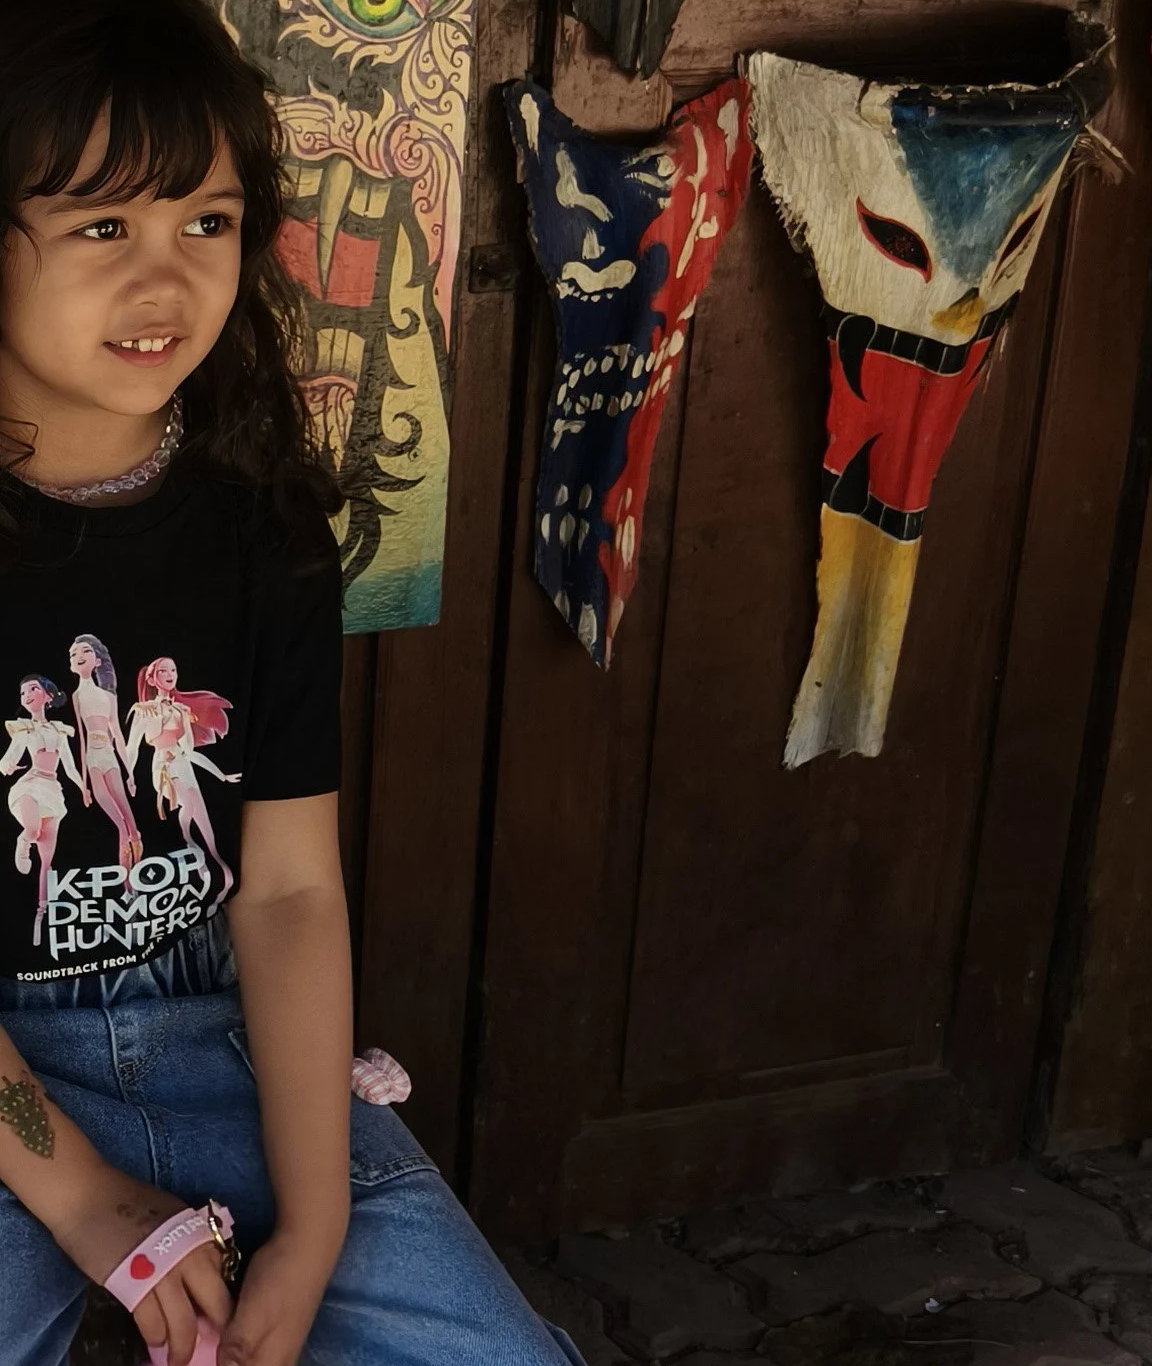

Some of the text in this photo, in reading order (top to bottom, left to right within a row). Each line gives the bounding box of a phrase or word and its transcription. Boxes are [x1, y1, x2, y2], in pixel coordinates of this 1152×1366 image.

[46, 847, 206, 901] K-POP
[47, 870, 212, 927] DEMON
[48, 898, 202, 962] HUNTERS
[16, 954, 137, 981] SOUNDTRACK FROM
[153, 1223, 192, 1256] Luck
